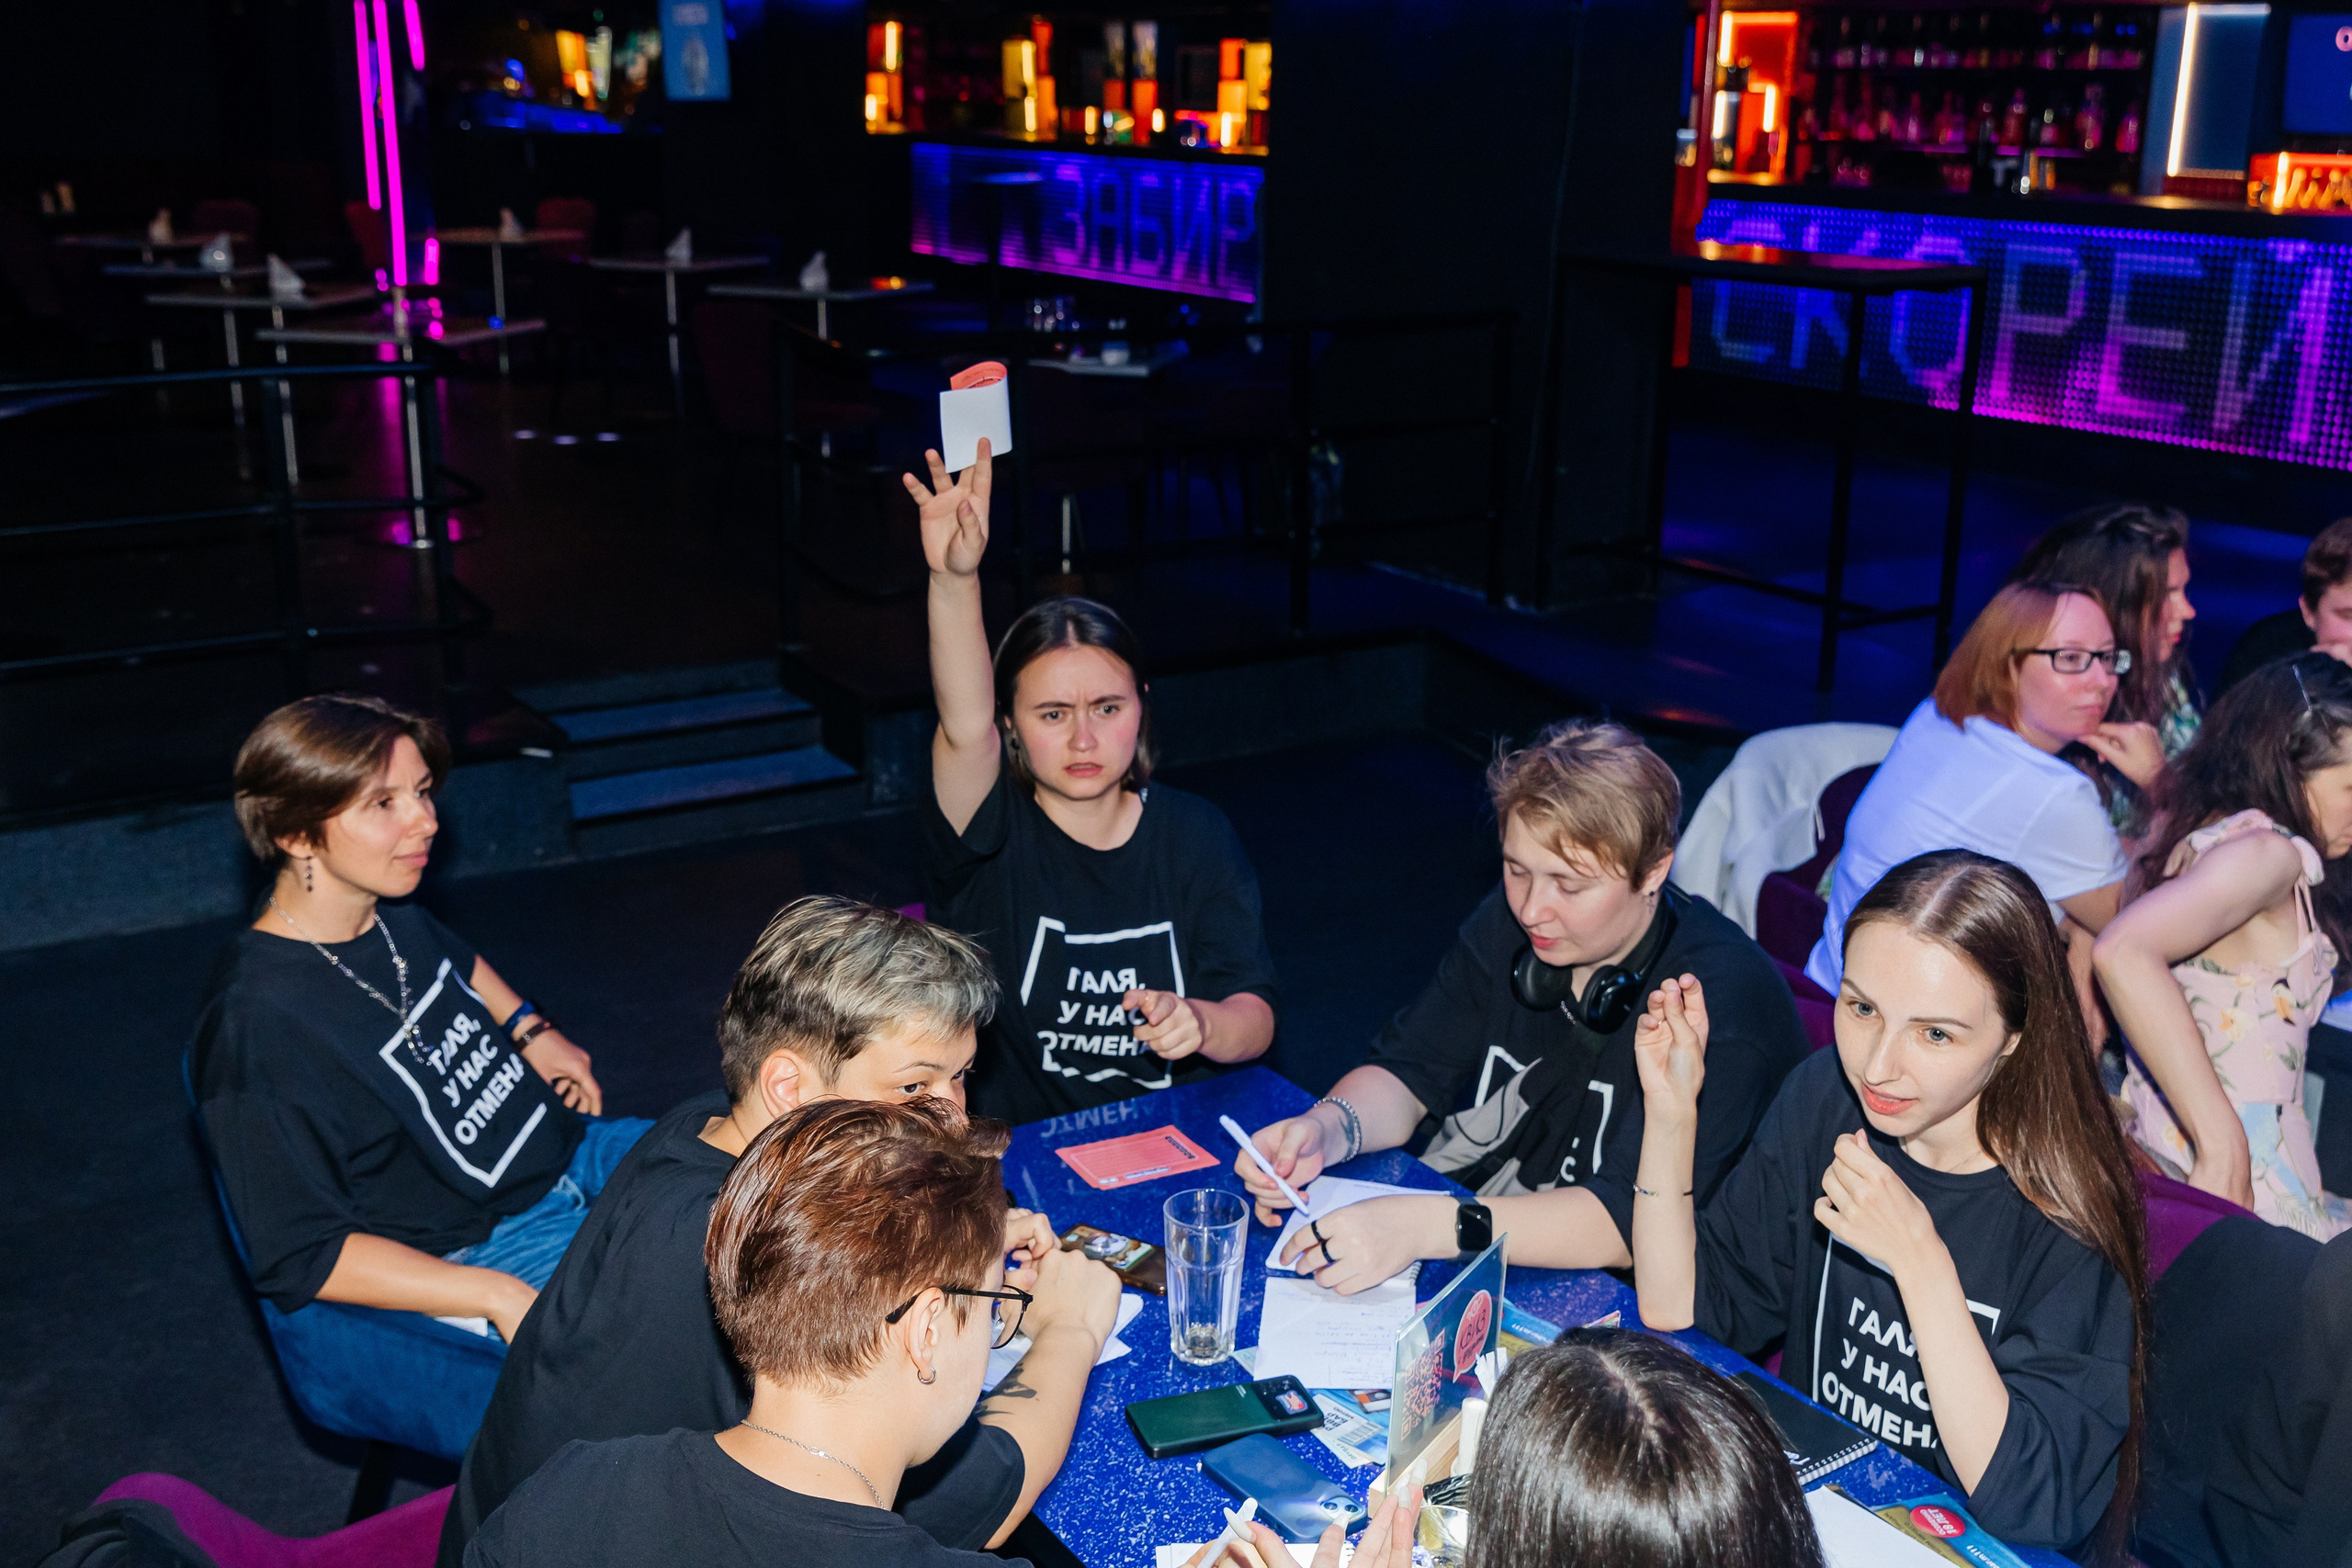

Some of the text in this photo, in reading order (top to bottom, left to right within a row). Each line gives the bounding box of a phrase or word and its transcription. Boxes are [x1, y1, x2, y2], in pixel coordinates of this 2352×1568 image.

[428, 1011, 481, 1076] ГАЛЯ,
[1057, 999, 1081, 1024] У
[442, 1033, 498, 1108] У НАС
[1822, 1371, 1939, 1450] ОТМЕН
[1840, 1337, 1932, 1412] У НАС
